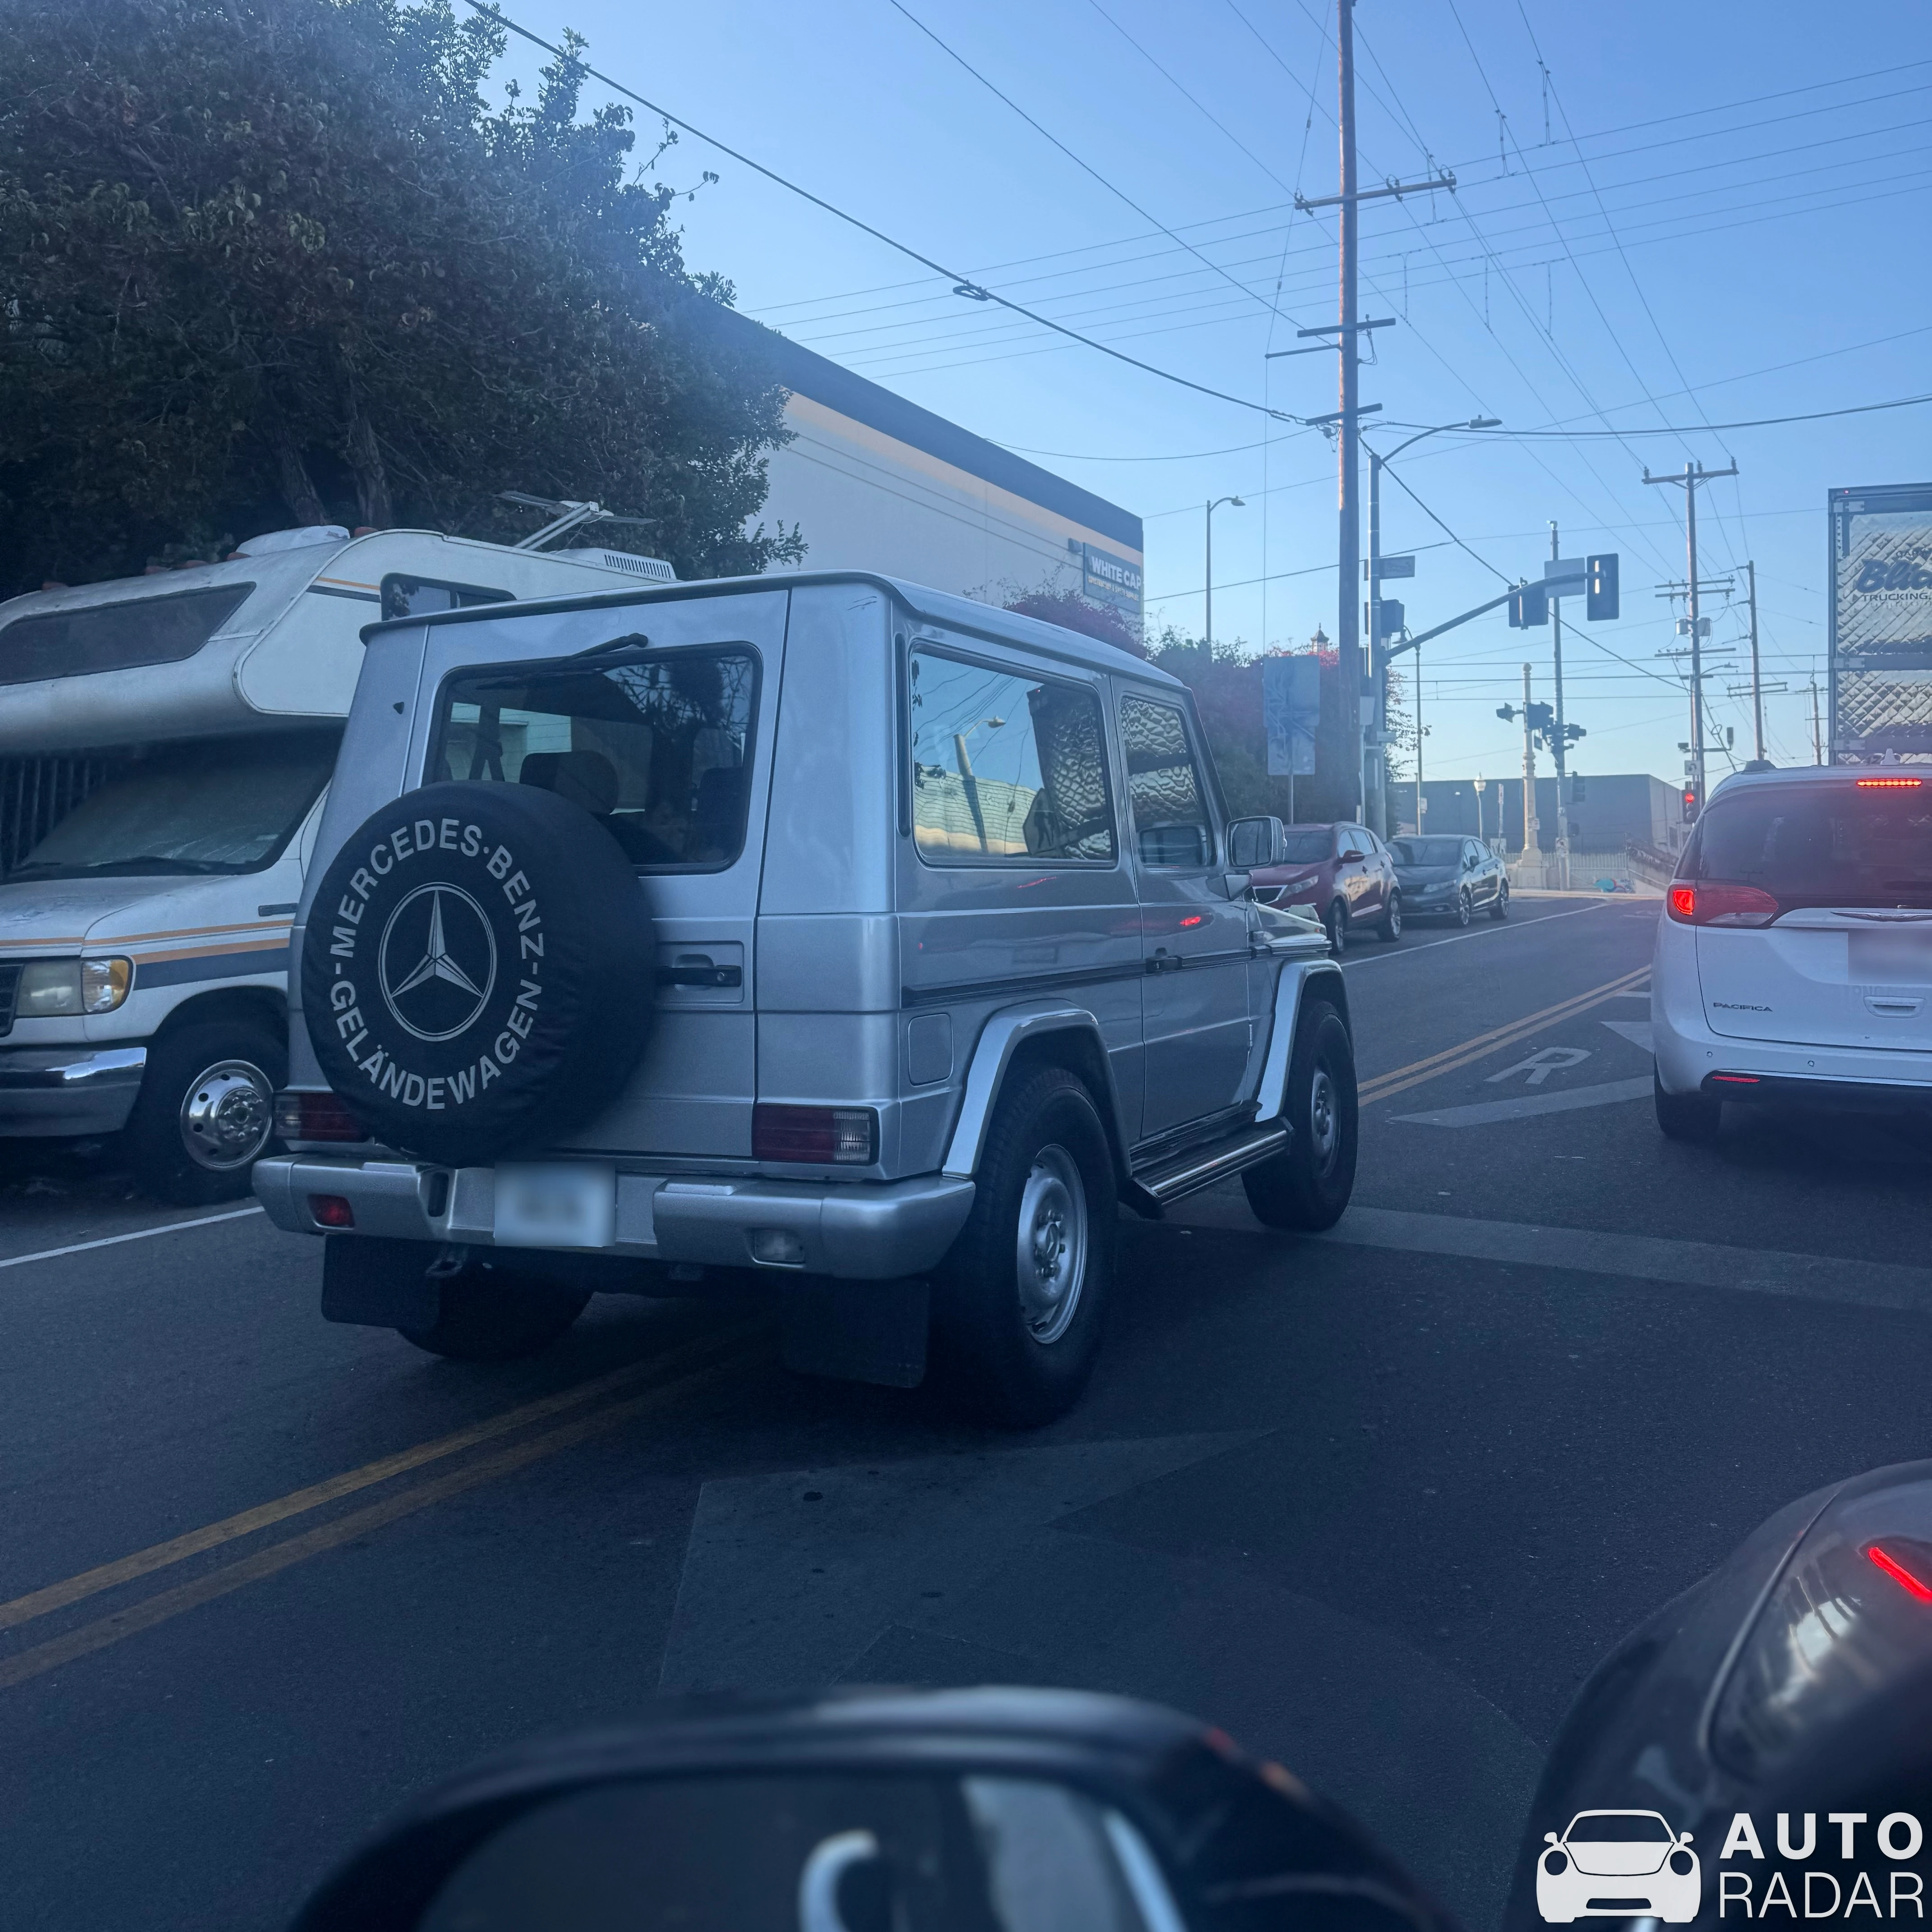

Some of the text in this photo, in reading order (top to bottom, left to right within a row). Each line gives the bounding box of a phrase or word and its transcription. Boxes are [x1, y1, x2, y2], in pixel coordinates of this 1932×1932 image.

[1091, 556, 1122, 584] WHITE
[1123, 570, 1141, 590] CAP
[1713, 1002, 1773, 1012] PACIFICA
[330, 979, 542, 1110] GELÄNDEWAGEN
